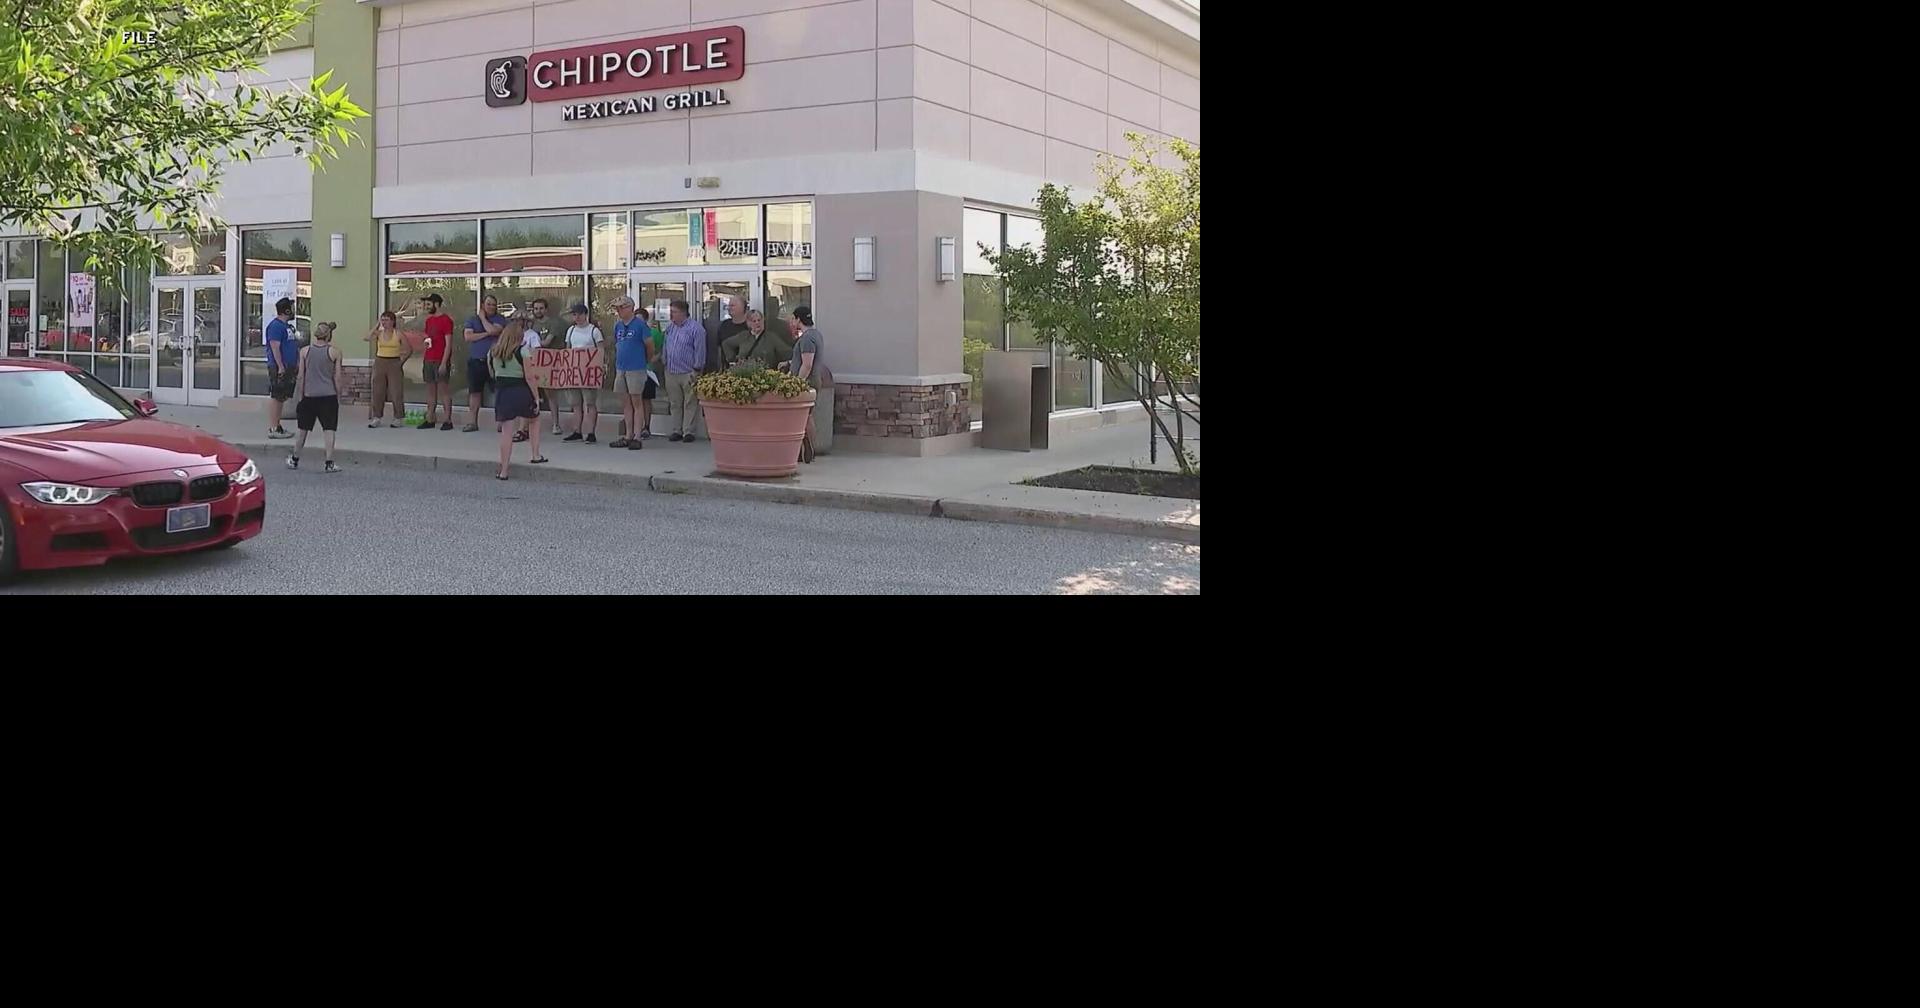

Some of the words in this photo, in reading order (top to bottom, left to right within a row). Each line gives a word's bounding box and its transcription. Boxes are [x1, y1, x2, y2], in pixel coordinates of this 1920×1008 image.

[533, 37, 729, 90] CHIPOTLE
[561, 97, 656, 121] MEXICAN
[664, 88, 730, 111] GRILL
[550, 366, 603, 388] FOREVER
